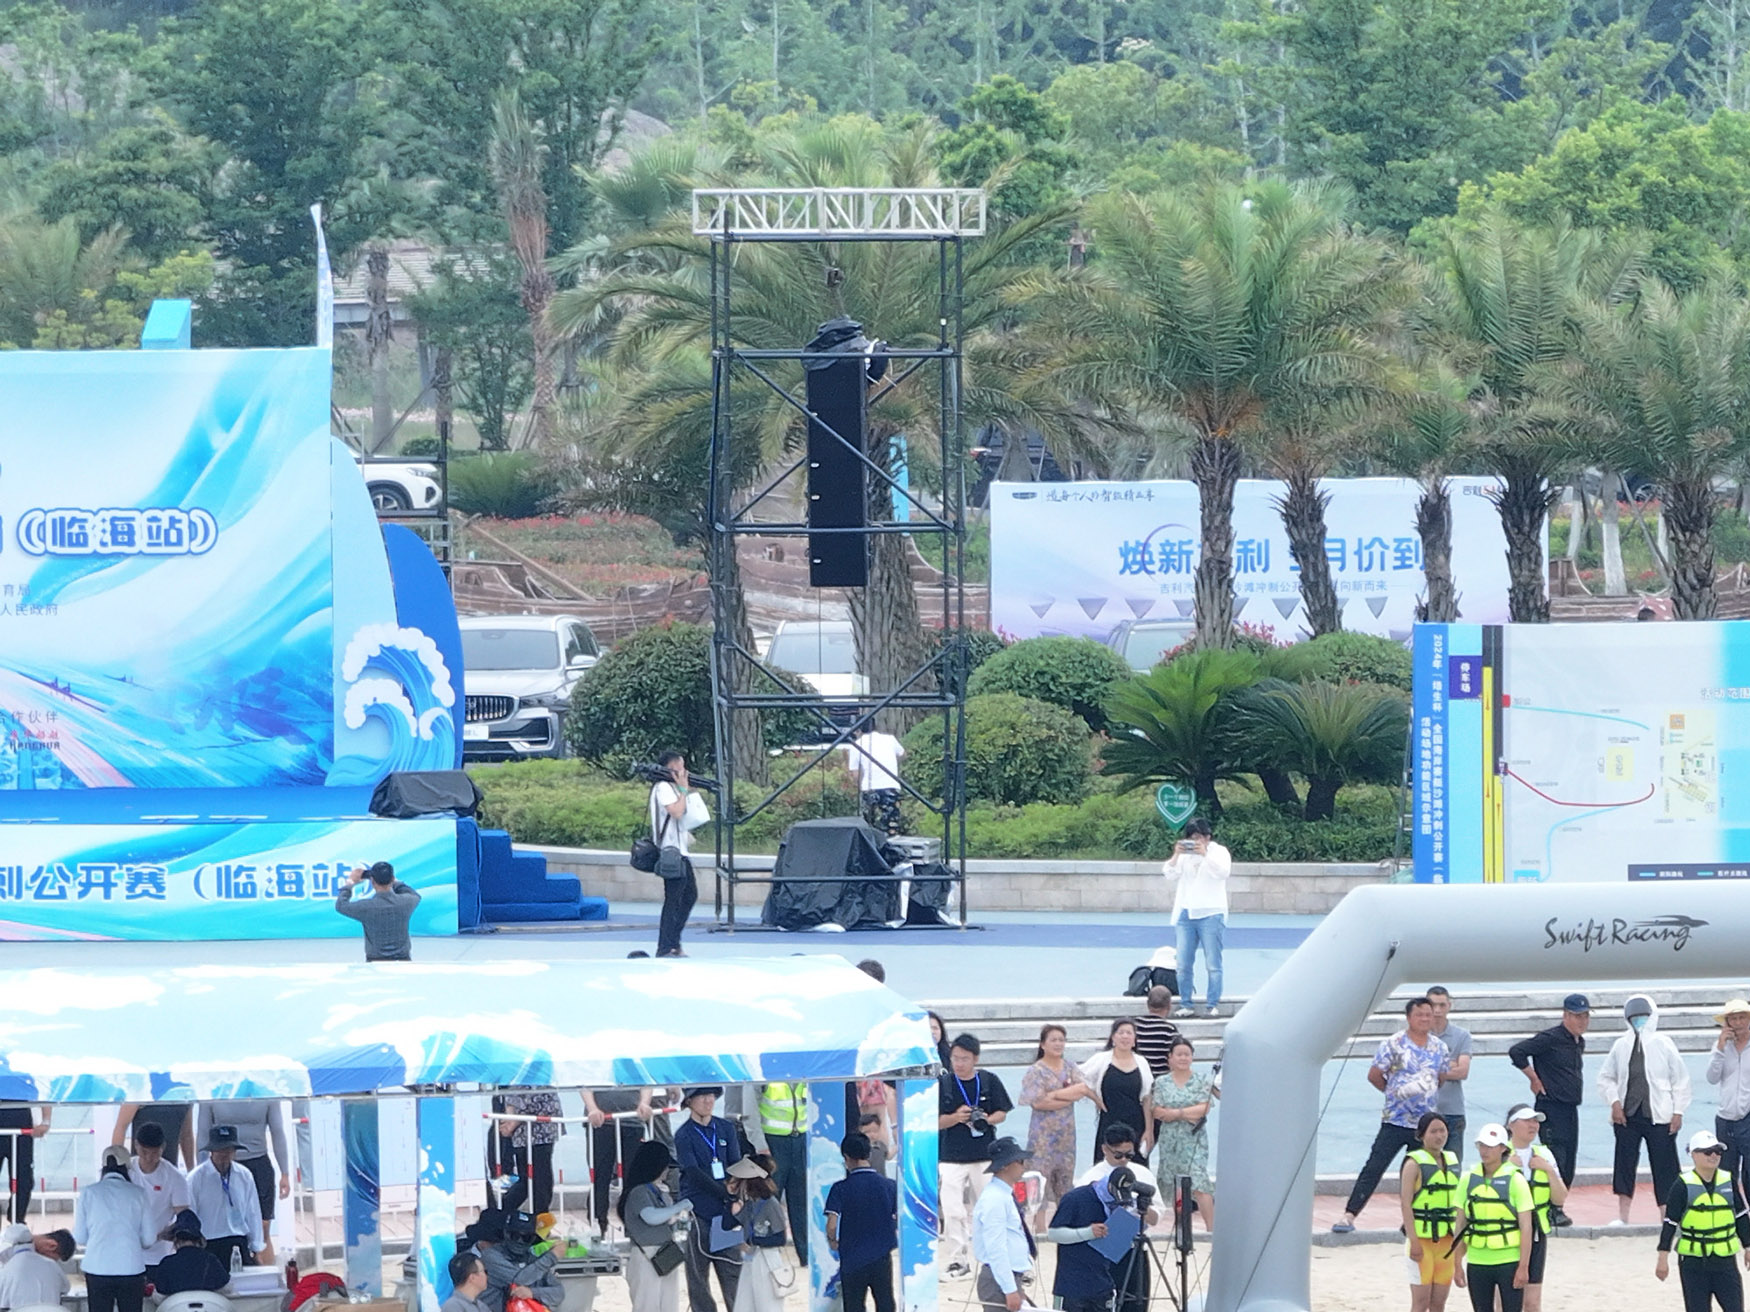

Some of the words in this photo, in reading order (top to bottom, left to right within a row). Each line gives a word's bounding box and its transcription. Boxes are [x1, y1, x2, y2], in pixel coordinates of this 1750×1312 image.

[1118, 537, 1271, 576] 焕新利
[1544, 917, 1608, 952] Swift
[1611, 918, 1692, 951] Racing
